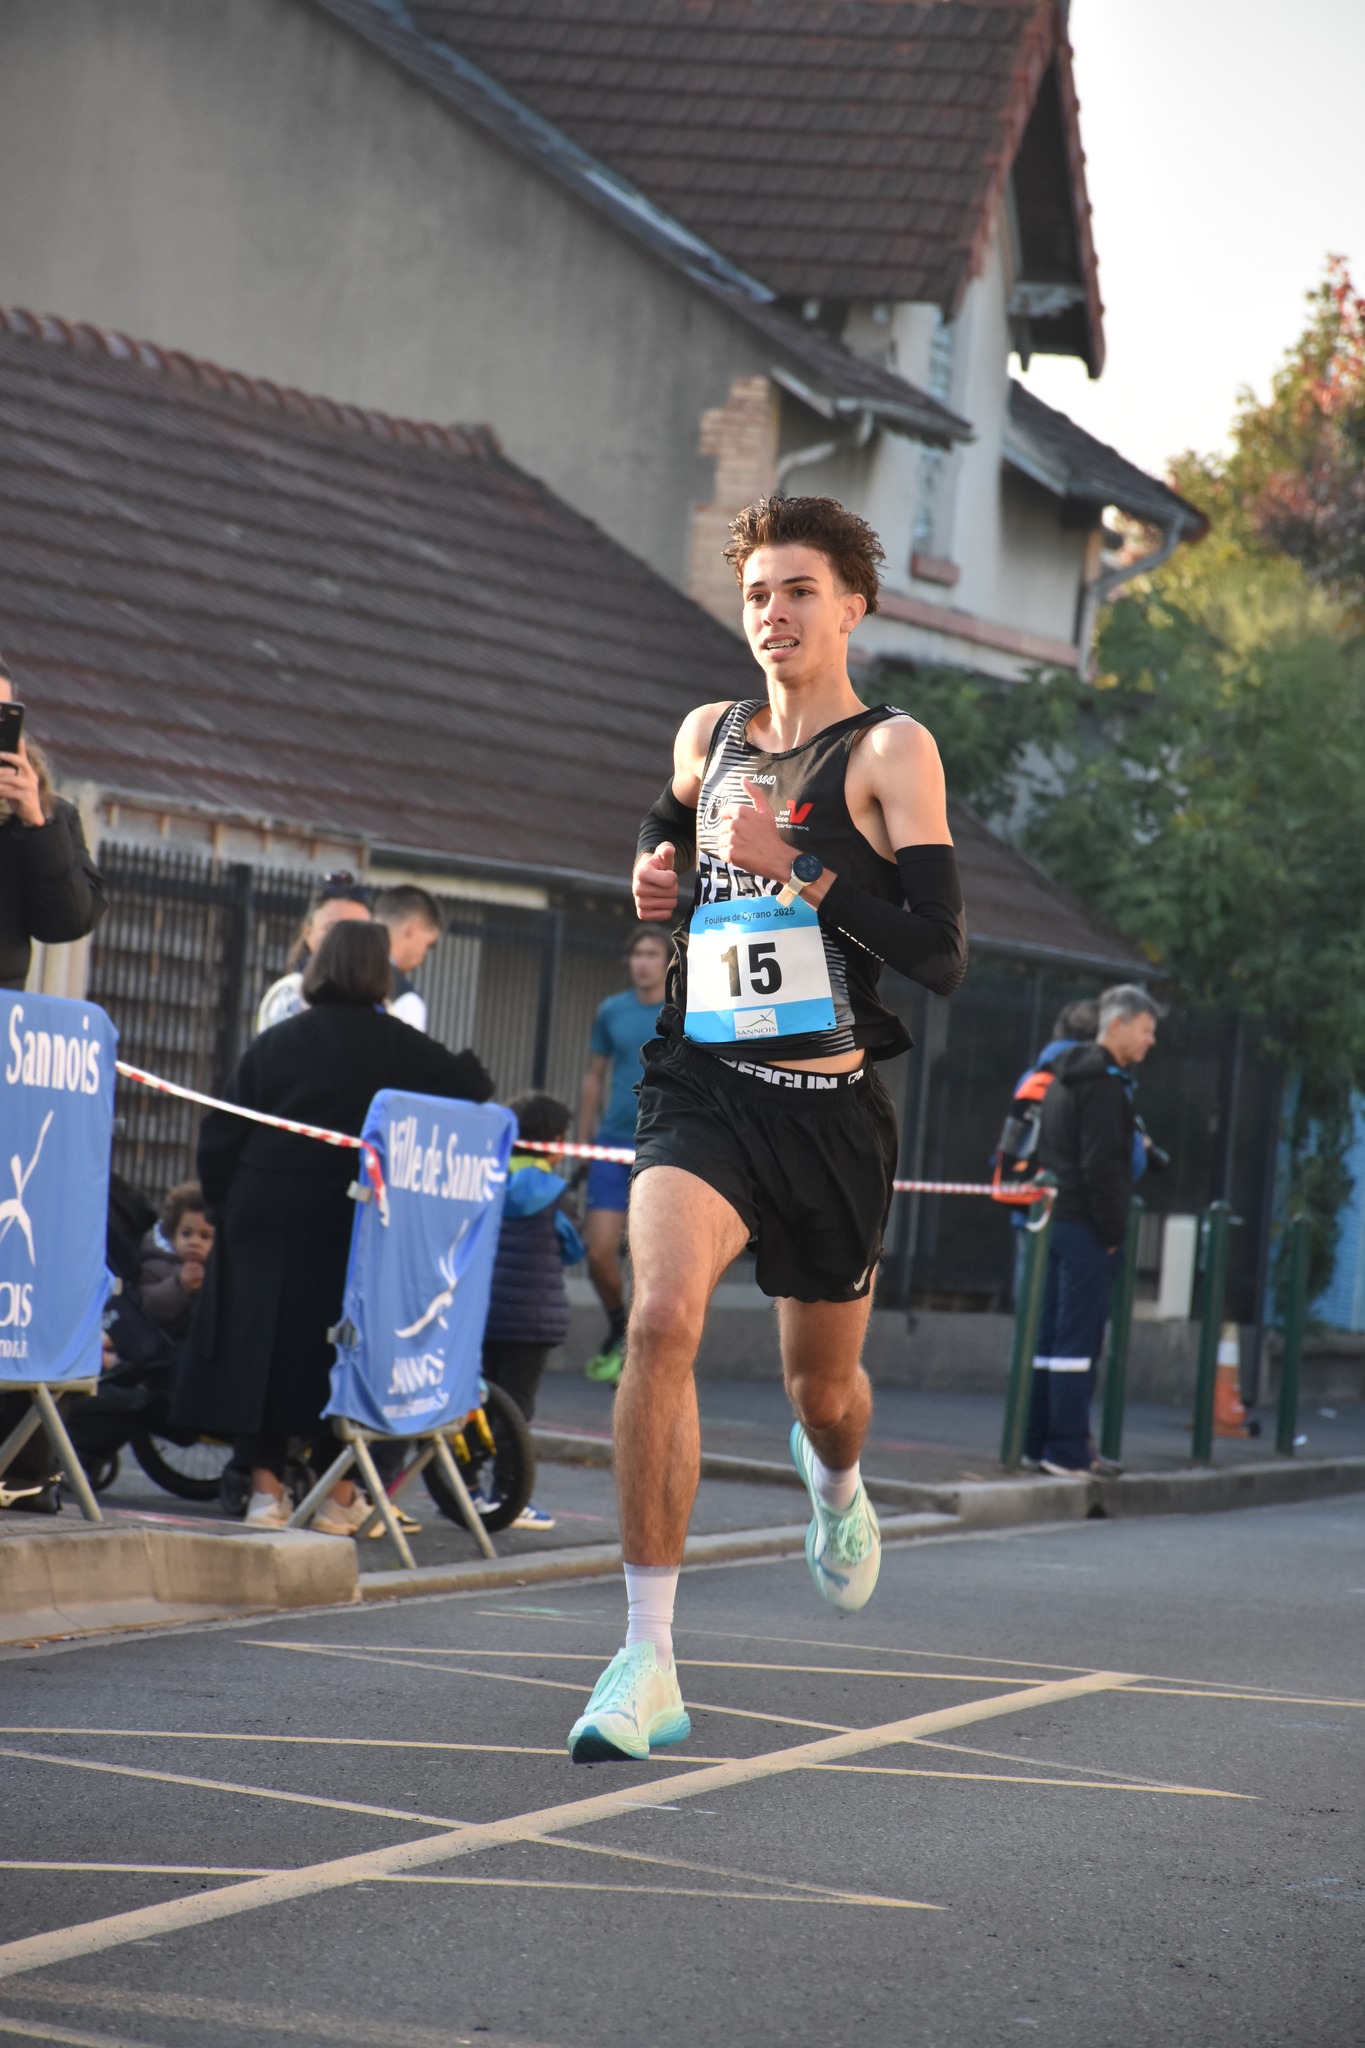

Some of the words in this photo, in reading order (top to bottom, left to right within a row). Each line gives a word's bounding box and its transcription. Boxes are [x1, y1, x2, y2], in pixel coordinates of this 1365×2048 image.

[704, 915, 731, 925] Foulées
[732, 913, 740, 921] de
[742, 911, 772, 921] Cyrano
[773, 907, 795, 917] 2025
[720, 942, 783, 997] 15
[6, 1004, 100, 1095] Sannois
[736, 1027, 777, 1036] SANNOIS
[422, 1124, 442, 1196] de
